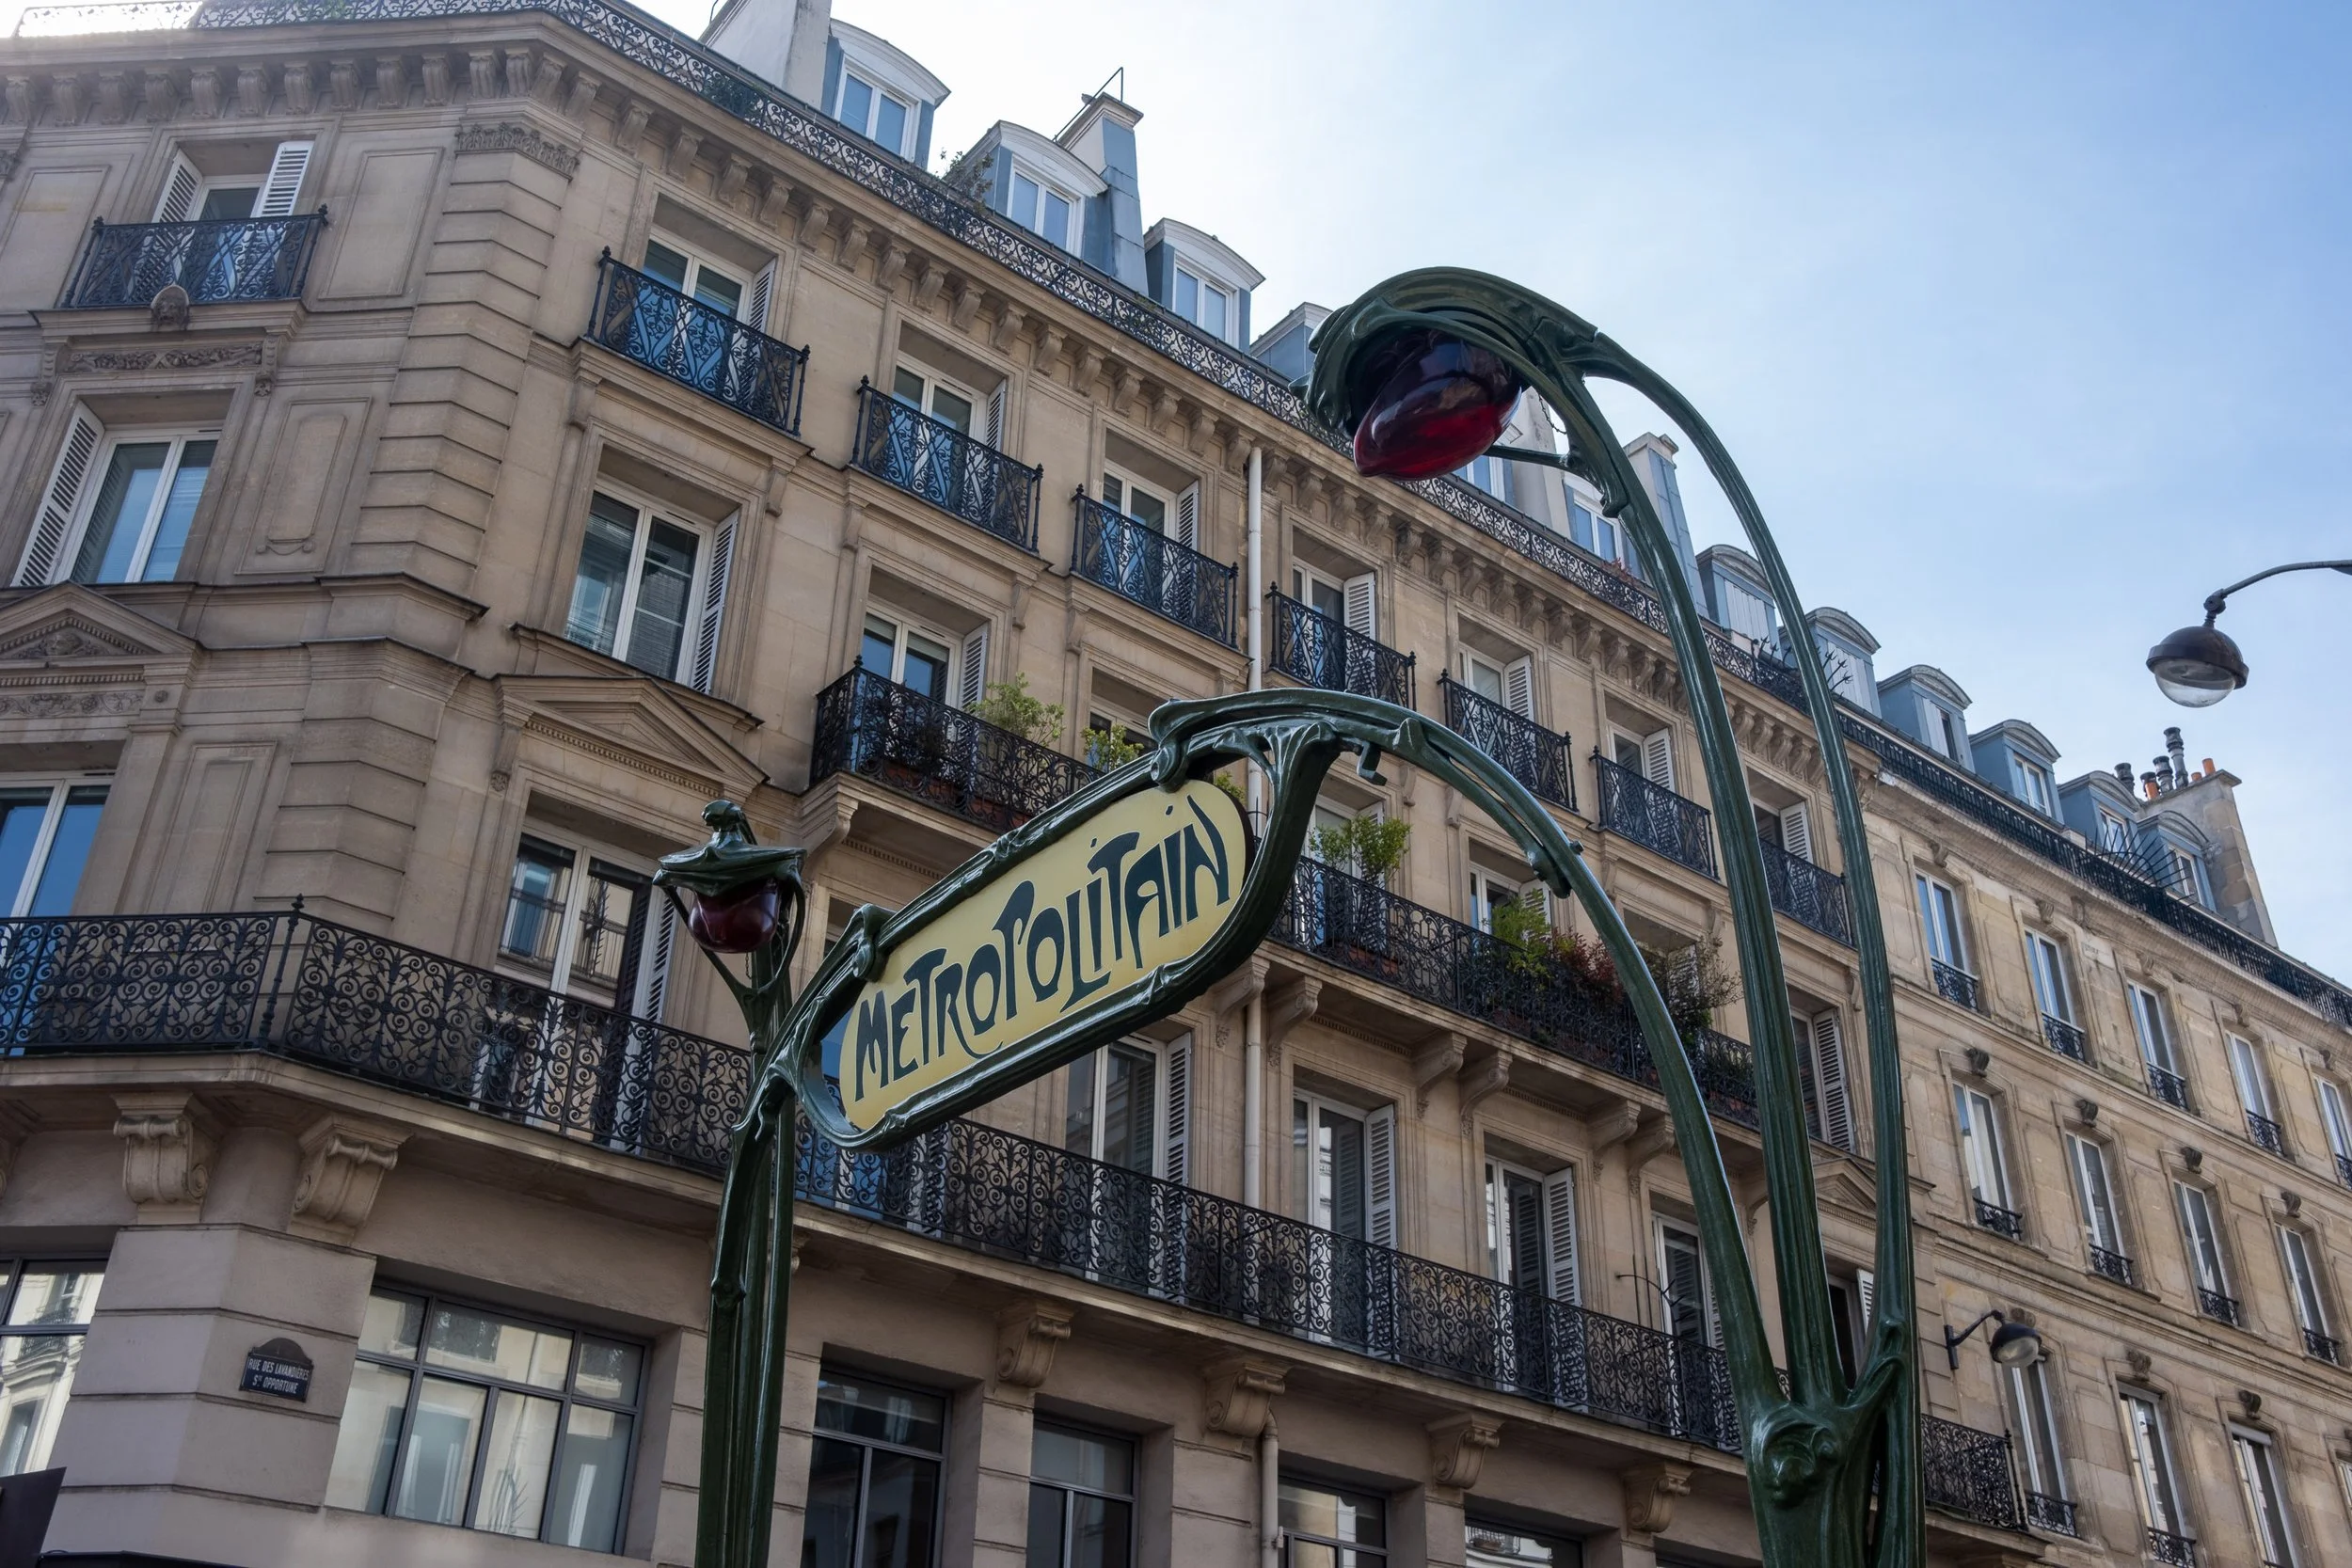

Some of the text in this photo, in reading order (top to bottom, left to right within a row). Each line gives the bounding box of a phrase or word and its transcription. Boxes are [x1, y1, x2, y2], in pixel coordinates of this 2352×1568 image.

[855, 795, 1230, 1101] METROPOLITAIN
[247, 1358, 262, 1371] RUE
[262, 1360, 275, 1373] DES
[262, 1376, 298, 1394] OPPORTUNE
